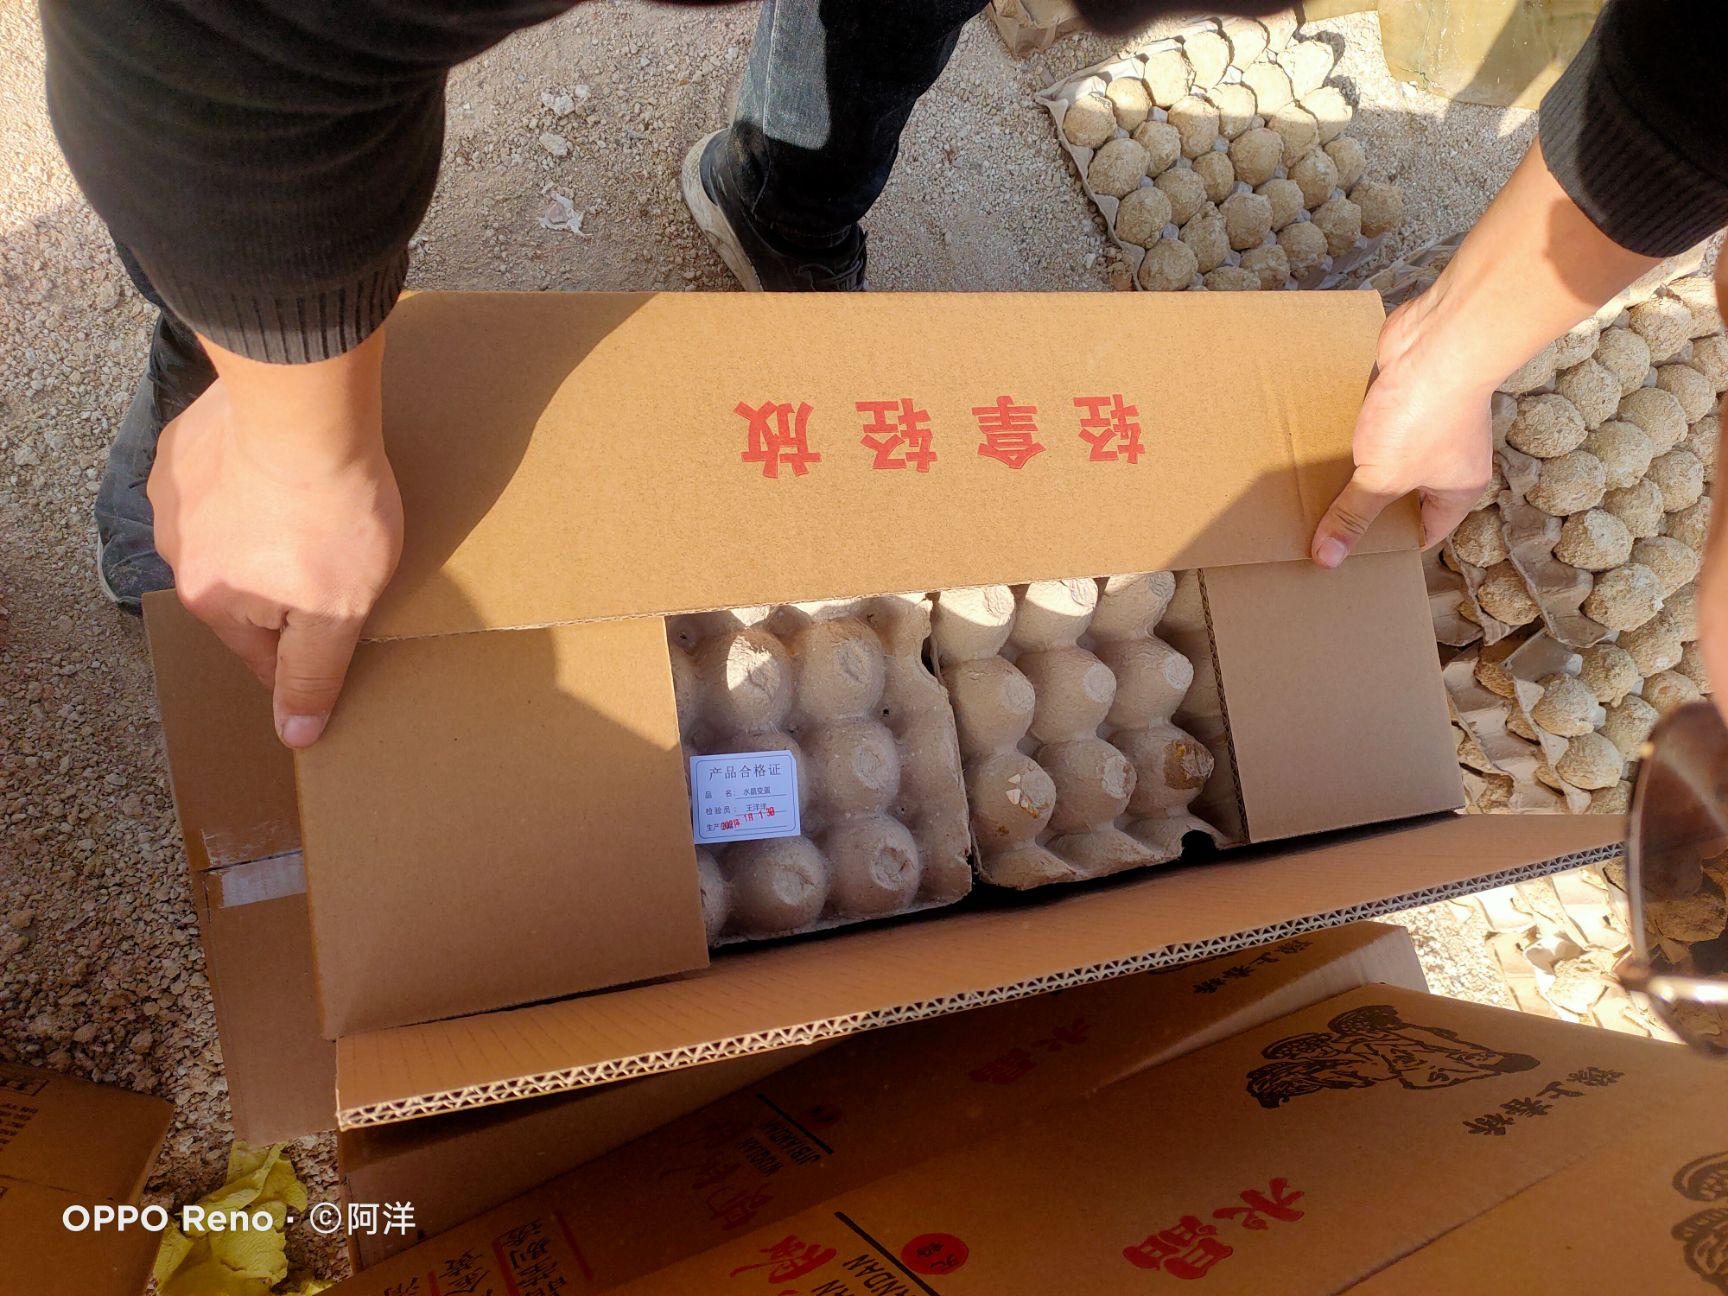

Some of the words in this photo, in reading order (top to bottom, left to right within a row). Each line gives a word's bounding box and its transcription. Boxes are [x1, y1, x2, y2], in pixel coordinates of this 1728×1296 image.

[733, 393, 1146, 479] 轻拿轻放
[709, 763, 782, 780] 产品合格证
[1122, 1176, 1304, 1280] 水晶
